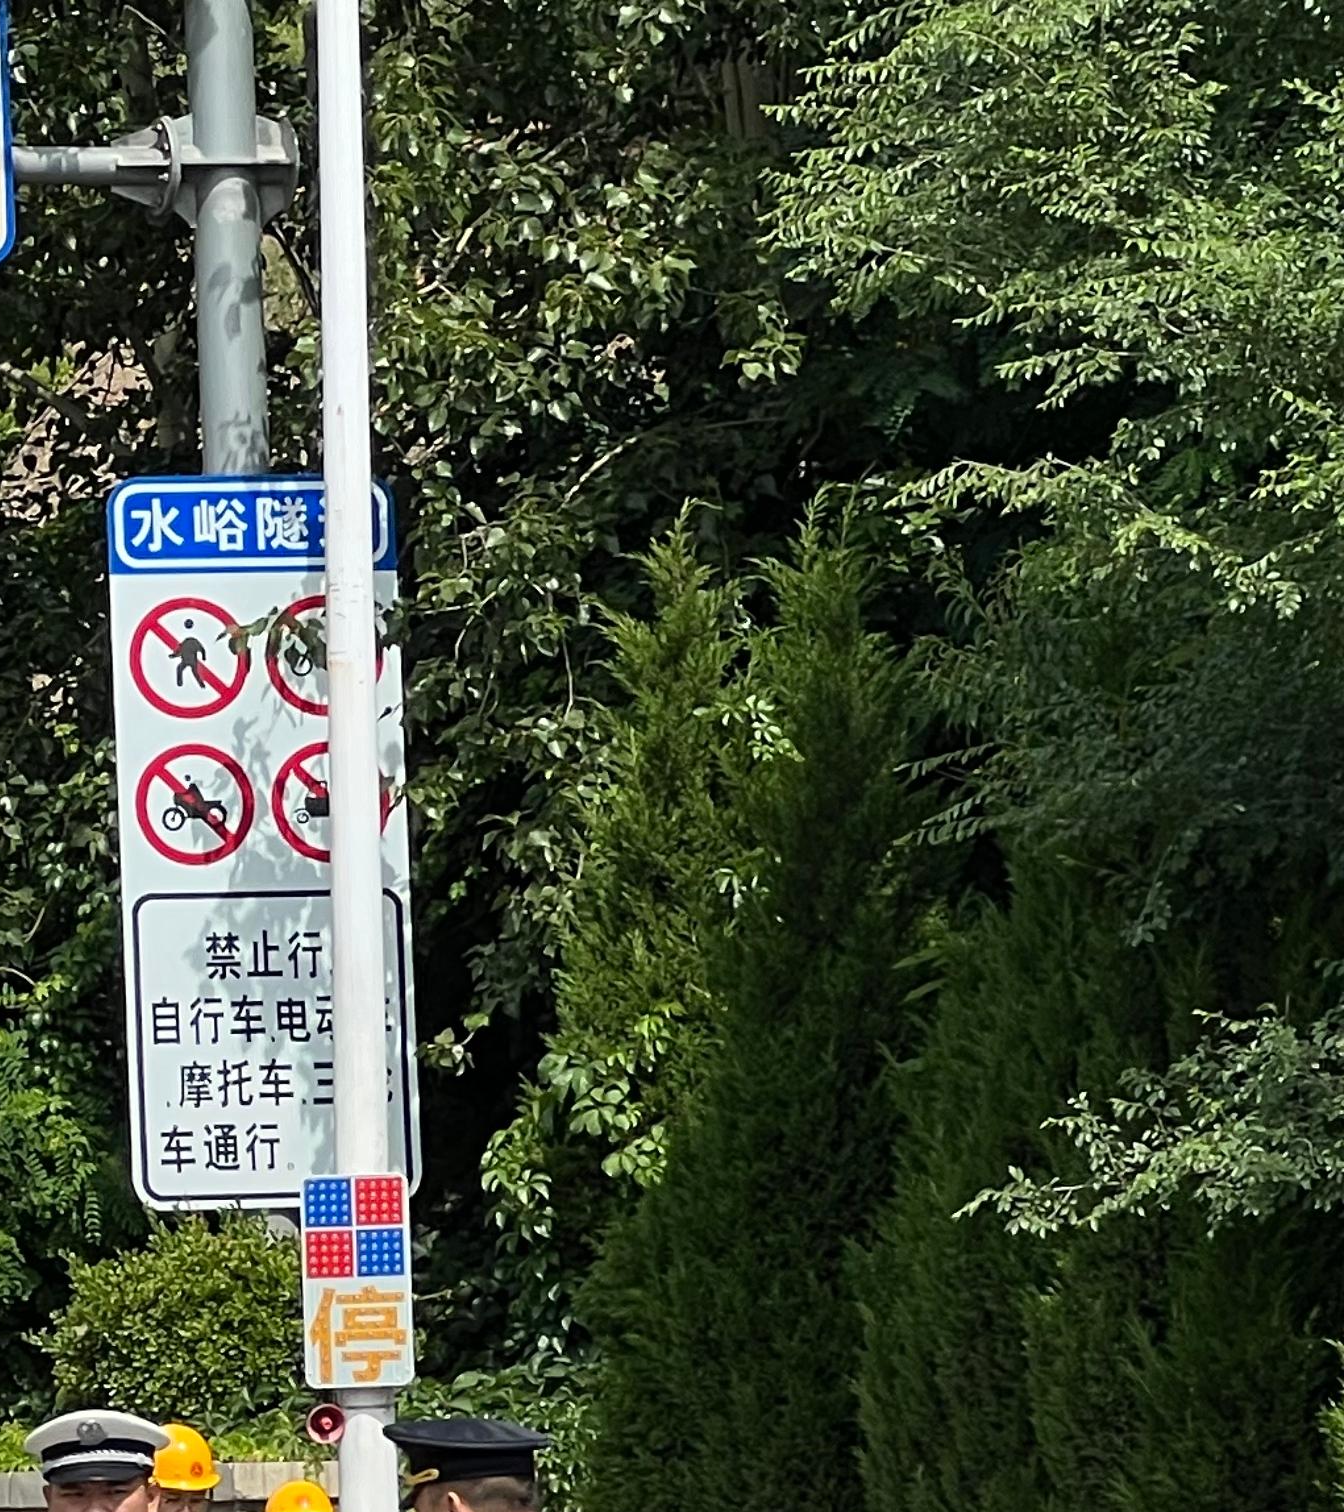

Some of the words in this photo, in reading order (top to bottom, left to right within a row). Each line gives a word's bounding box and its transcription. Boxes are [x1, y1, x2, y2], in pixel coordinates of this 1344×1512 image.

[129, 497, 326, 553] 水峪隧
[205, 930, 333, 981] 禁止行
[308, 1285, 408, 1384] 停
